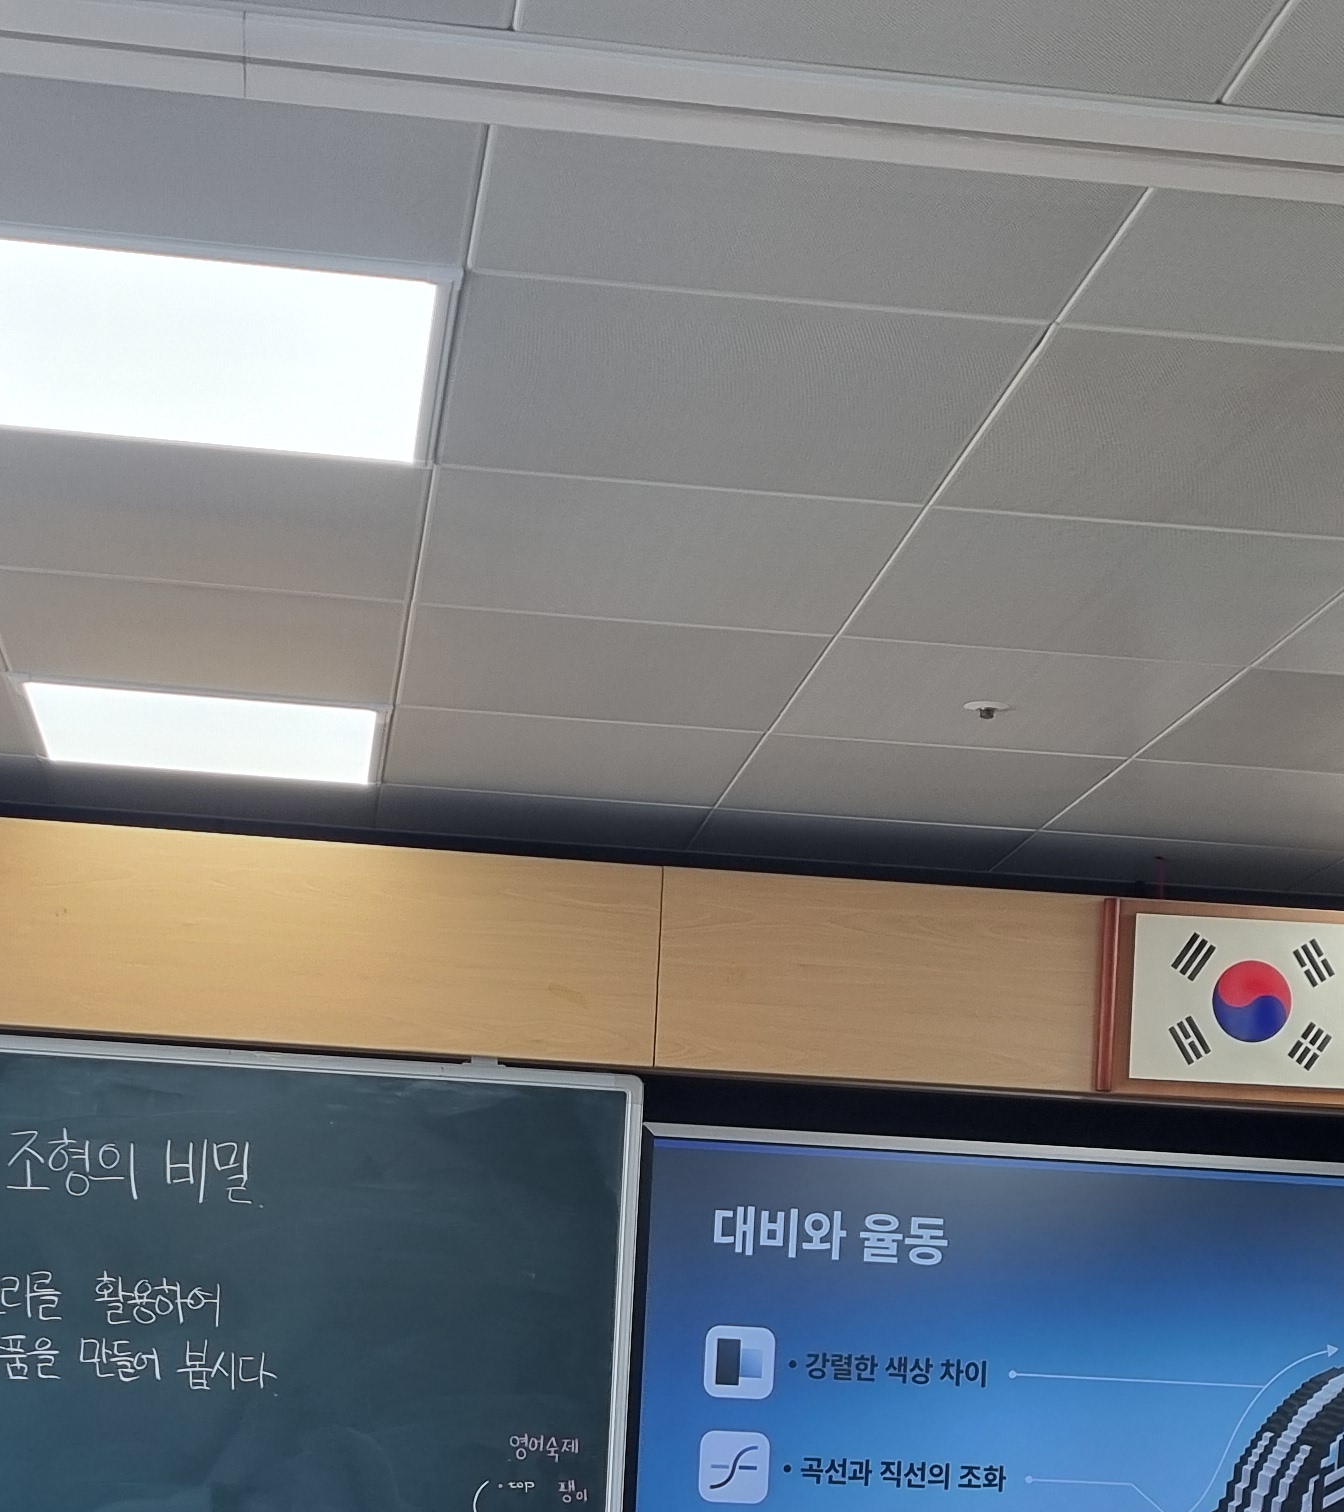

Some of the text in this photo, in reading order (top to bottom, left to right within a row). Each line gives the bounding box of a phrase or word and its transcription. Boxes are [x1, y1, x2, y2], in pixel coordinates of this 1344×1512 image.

[6, 1127, 138, 1200] 조형의
[713, 1205, 949, 1266] 대비와 율동
[95, 1270, 221, 1327] 활용하여
[79, 1338, 162, 1381] 만들어
[805, 1353, 988, 1388] 강렬한 색상 차이
[509, 1433, 579, 1462] 영어숙제
[507, 1479, 588, 1503] top 팽이
[800, 1457, 1007, 1492] 곡선과 직선의 조화
